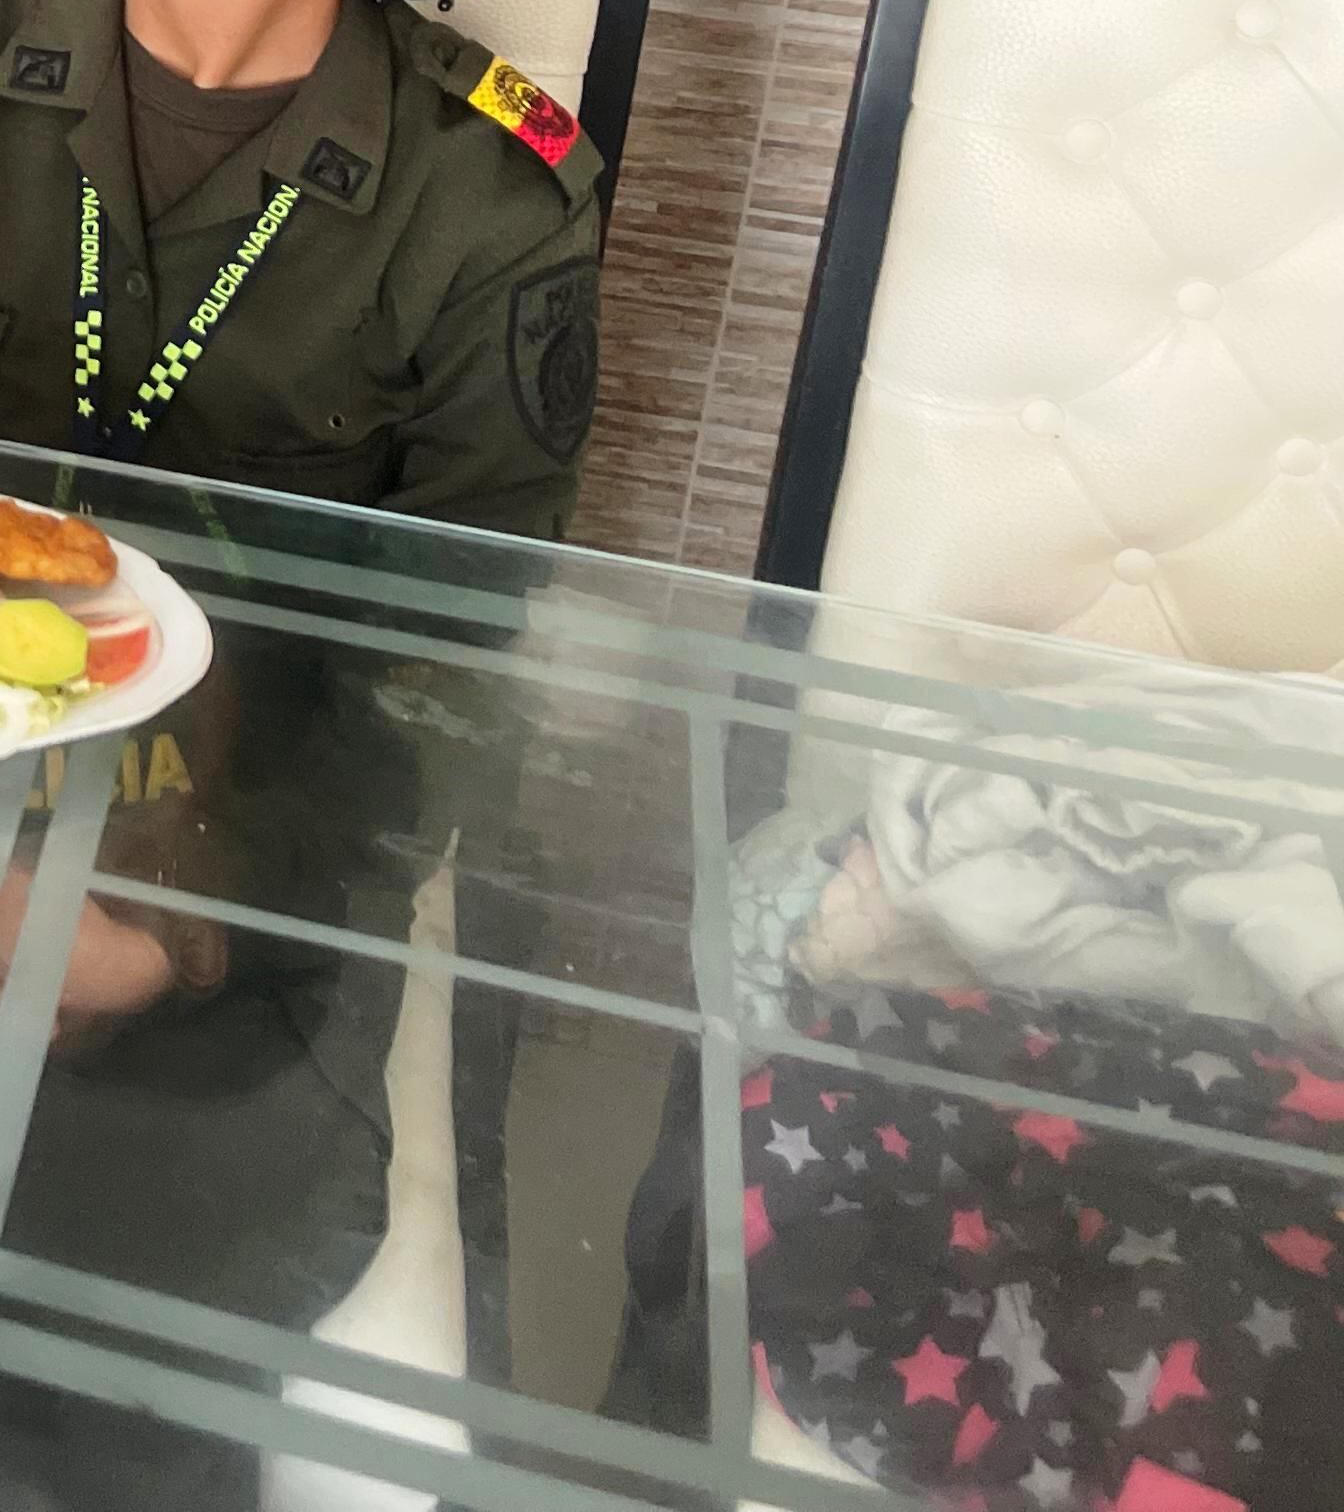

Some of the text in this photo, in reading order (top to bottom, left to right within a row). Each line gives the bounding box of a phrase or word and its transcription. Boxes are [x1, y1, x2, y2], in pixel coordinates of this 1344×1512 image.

[79, 187, 100, 297] NACIONAL
[188, 184, 300, 336] POLICÍA NACION
